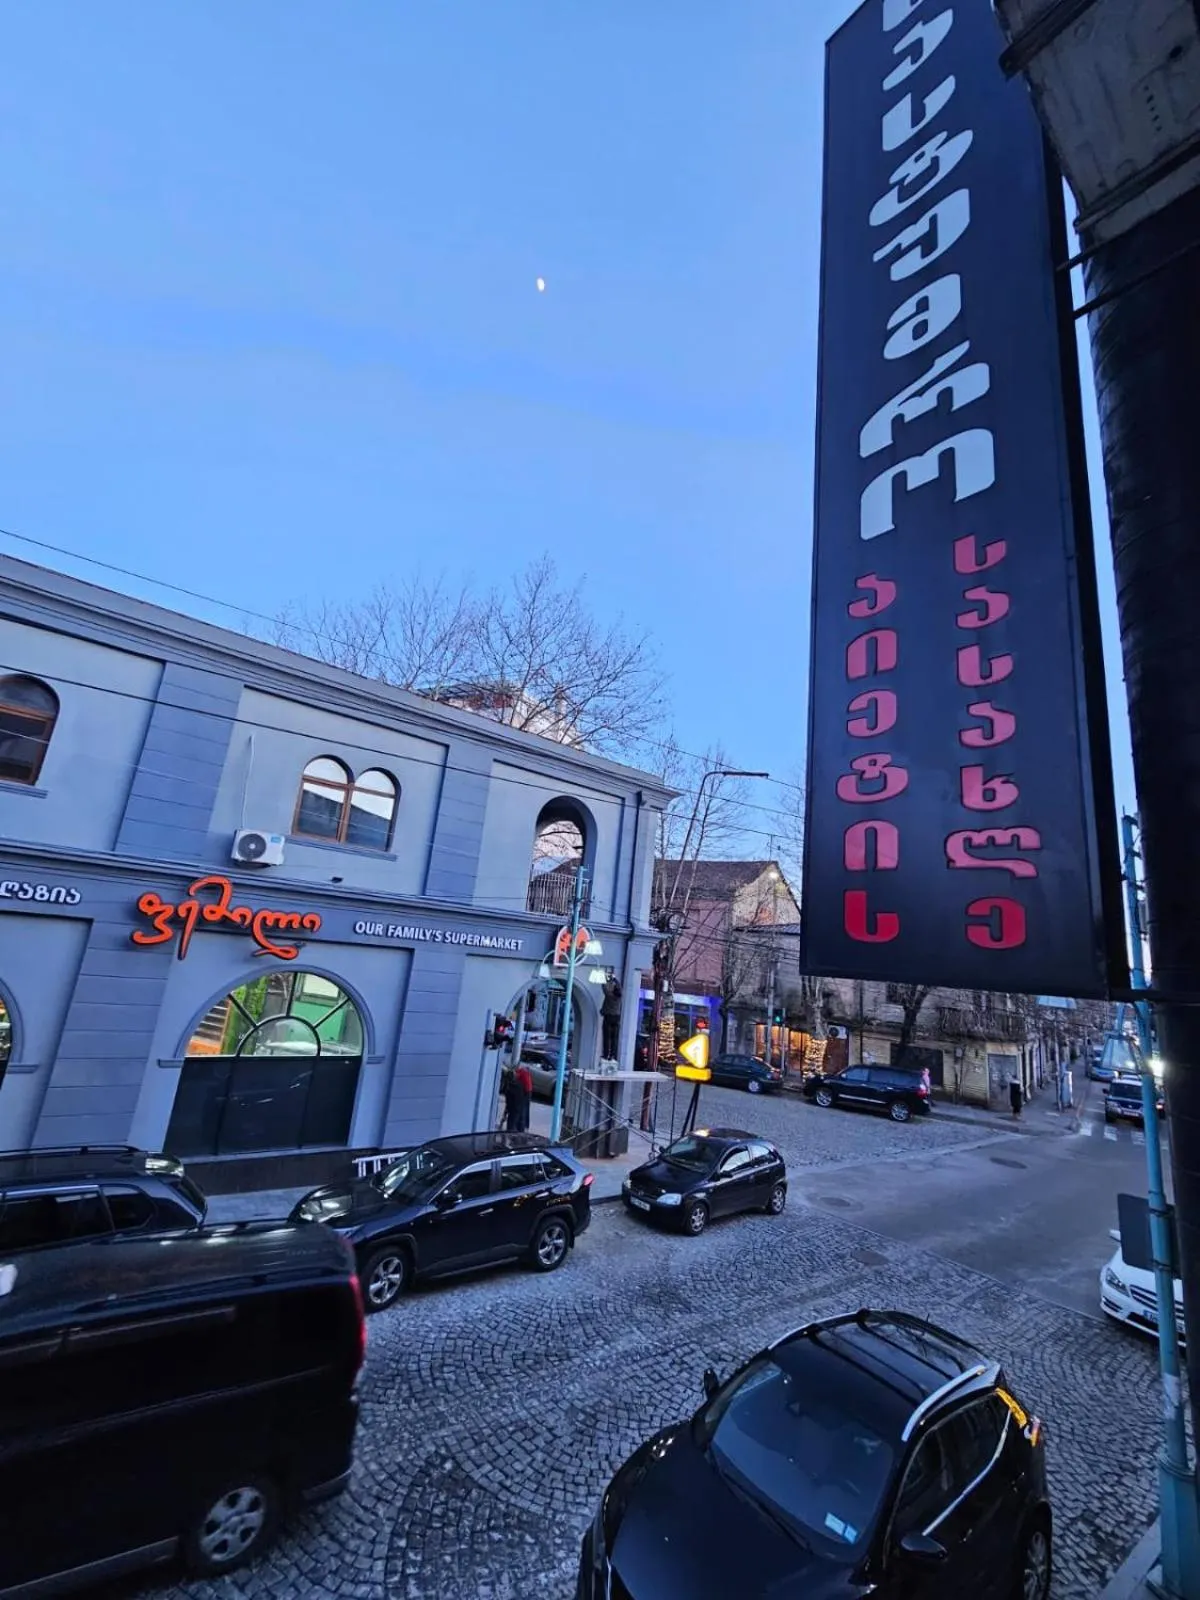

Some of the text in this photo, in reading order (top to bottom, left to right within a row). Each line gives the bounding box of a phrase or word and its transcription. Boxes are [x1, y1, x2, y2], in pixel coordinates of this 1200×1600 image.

[835, 572, 908, 943] აიეტის
[944, 534, 1041, 949] სასახლე
[132, 875, 322, 960] ფემილი
[355, 921, 524, 951] OUR FAMILY'S SUPERMARKET
